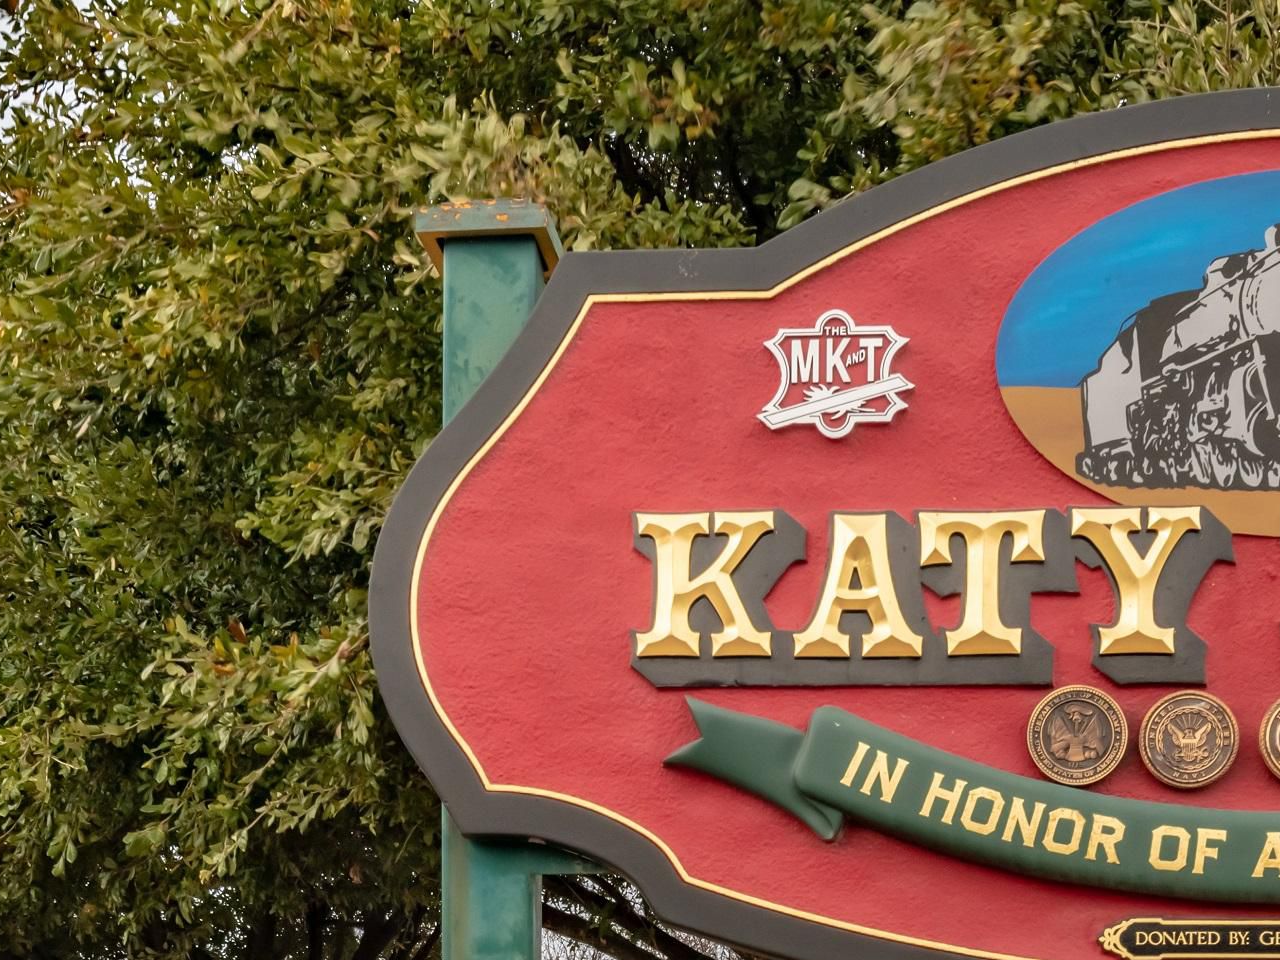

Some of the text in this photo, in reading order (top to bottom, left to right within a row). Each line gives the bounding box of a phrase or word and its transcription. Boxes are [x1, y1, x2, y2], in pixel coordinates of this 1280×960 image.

[824, 326, 847, 336] THE
[845, 349, 866, 367] AND
[637, 505, 1202, 658] KATY
[1034, 692, 1076, 732] DEPARTMENT
[1094, 695, 1110, 710] THE
[1108, 709, 1121, 732] ARMY
[1149, 704, 1174, 748] UNITED
[1034, 740, 1120, 779] UNITED STATES OF AMERICA
[1172, 771, 1207, 779] NAVY
[840, 741, 910, 804] IN
[919, 771, 1126, 865] HONOR
[1148, 824, 1228, 875] OF
[1135, 931, 1221, 946] DONATED
[1228, 931, 1250, 946] BY:
